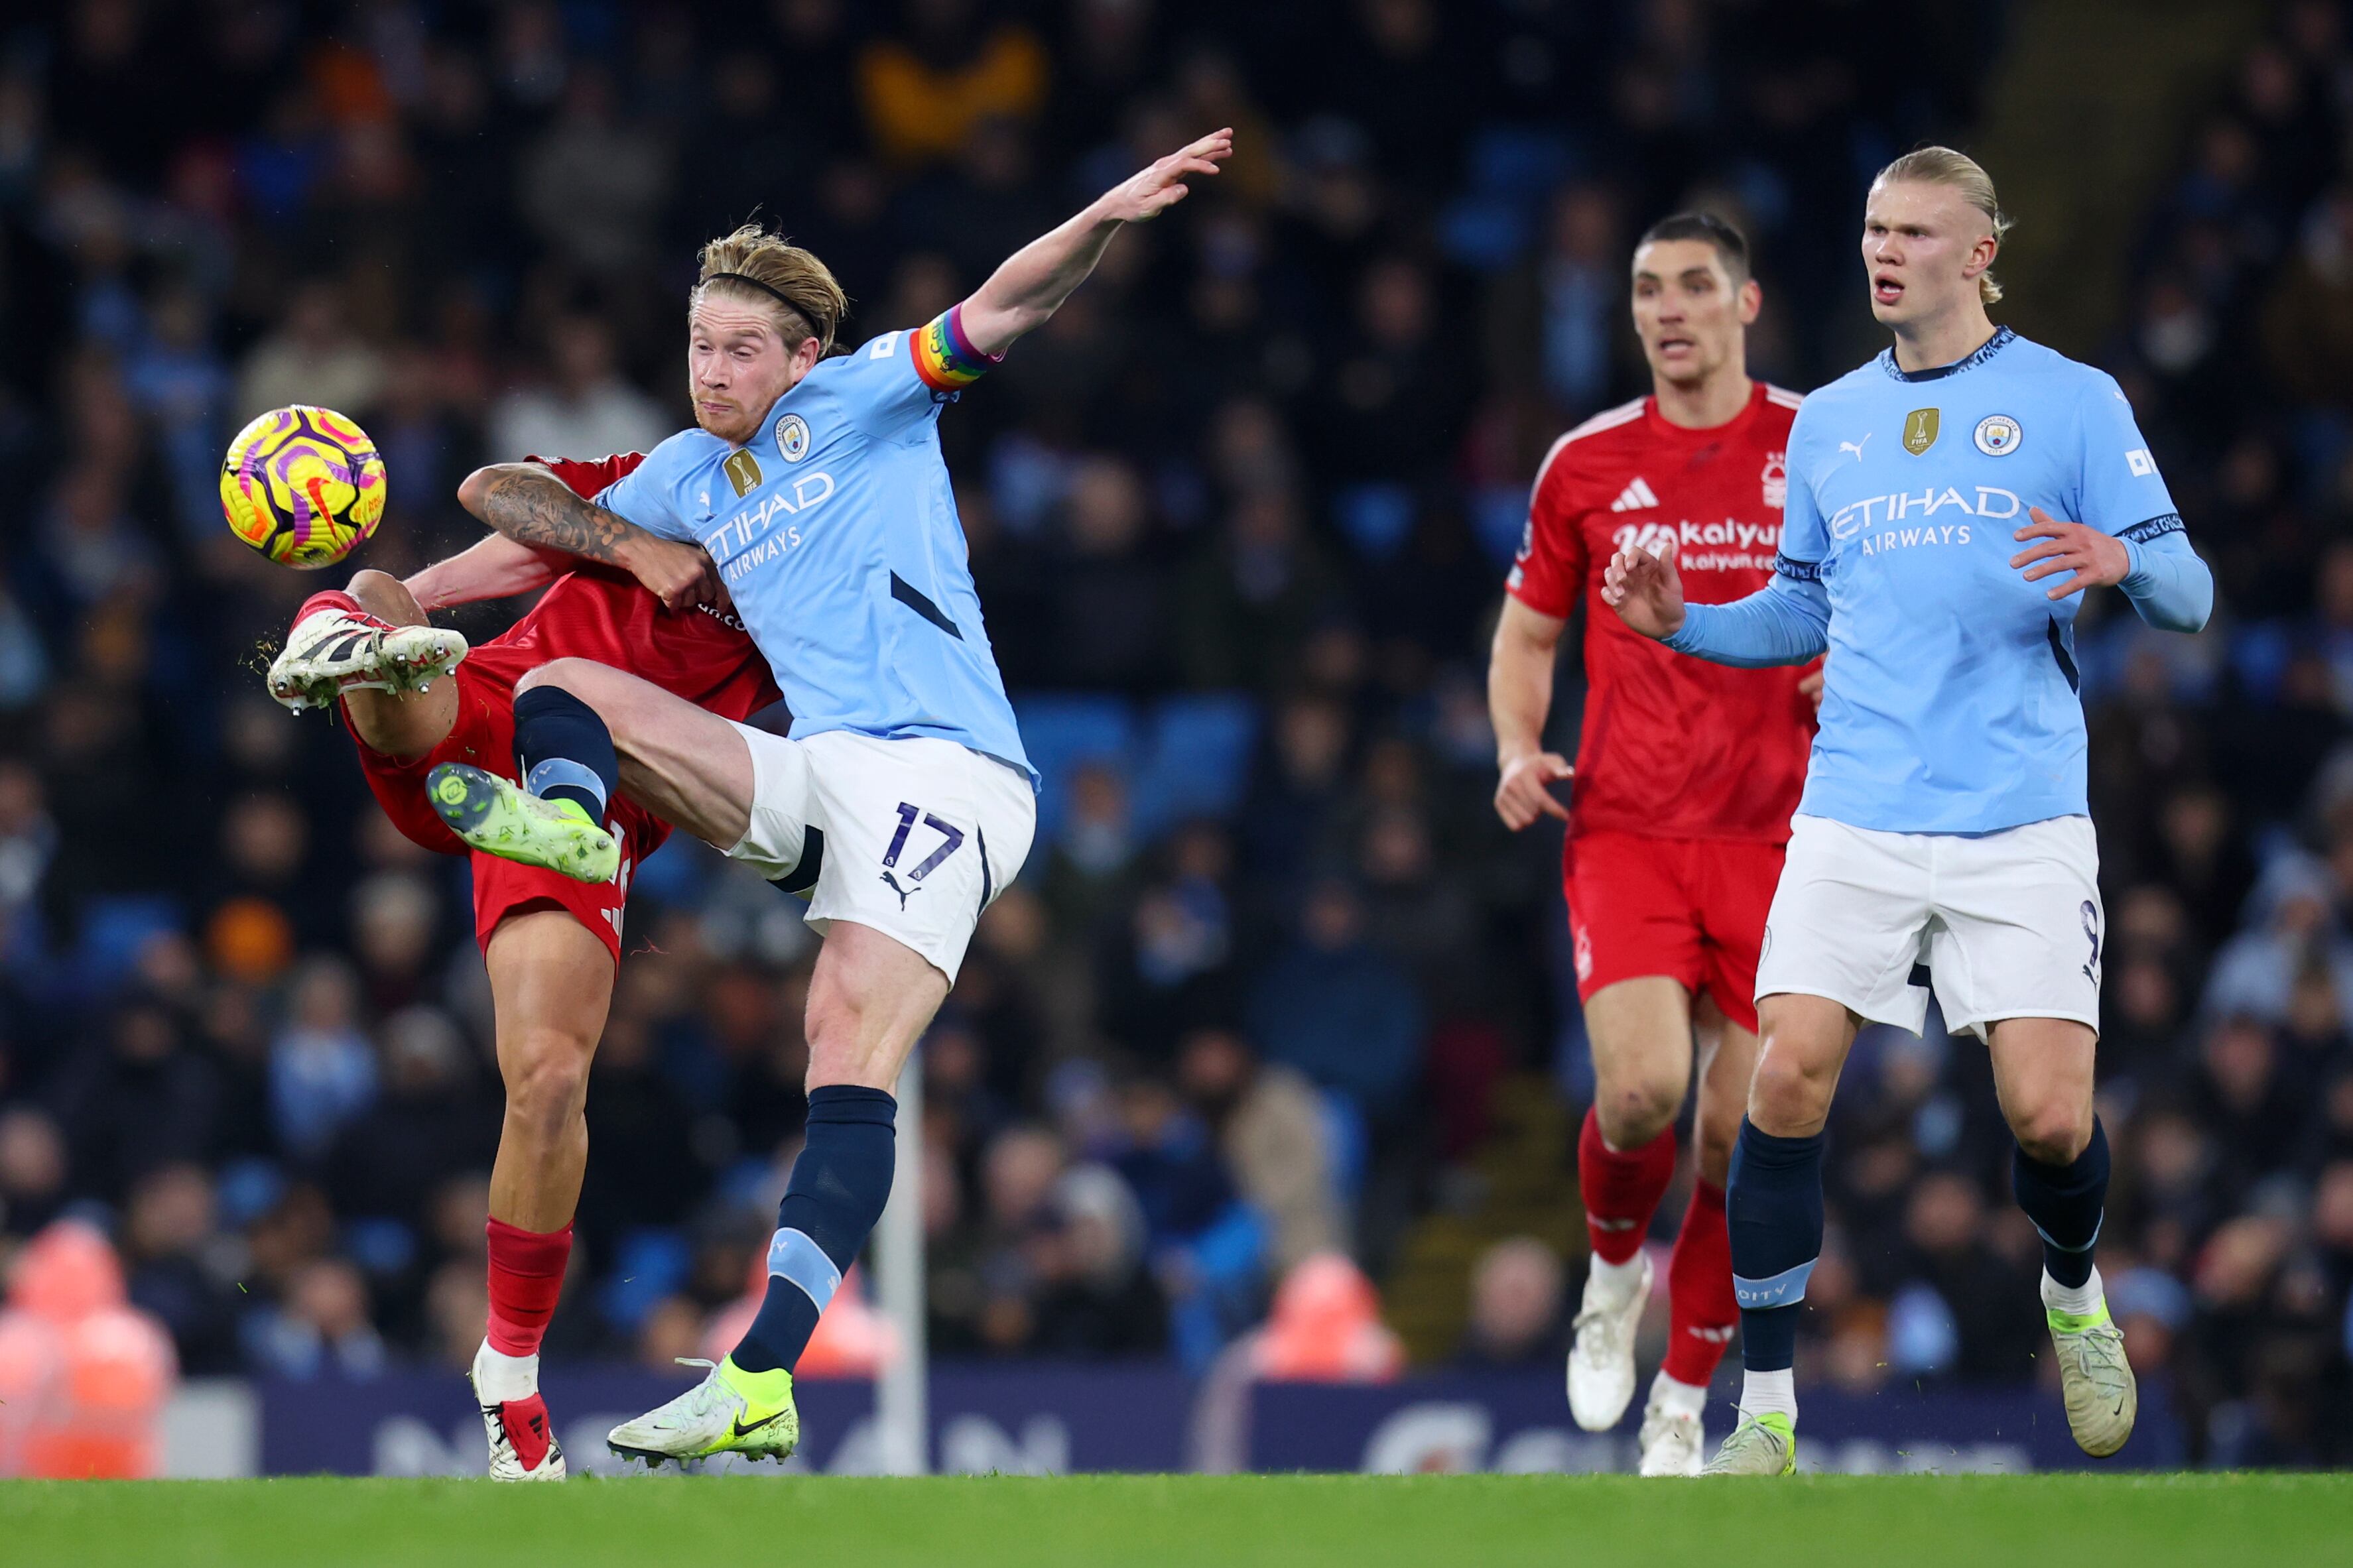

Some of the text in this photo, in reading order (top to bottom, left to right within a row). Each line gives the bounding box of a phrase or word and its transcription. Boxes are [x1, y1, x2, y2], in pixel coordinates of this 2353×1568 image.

[1980, 418, 2018, 432] MANCHESTER
[743, 481, 757, 495] FIFA
[1831, 486, 2021, 540] ETIHAD
[729, 526, 801, 583] AIRWAYS
[1862, 525, 1971, 556] AIRWAYS
[882, 802, 965, 882] 17
[2080, 900, 2099, 968] 9
